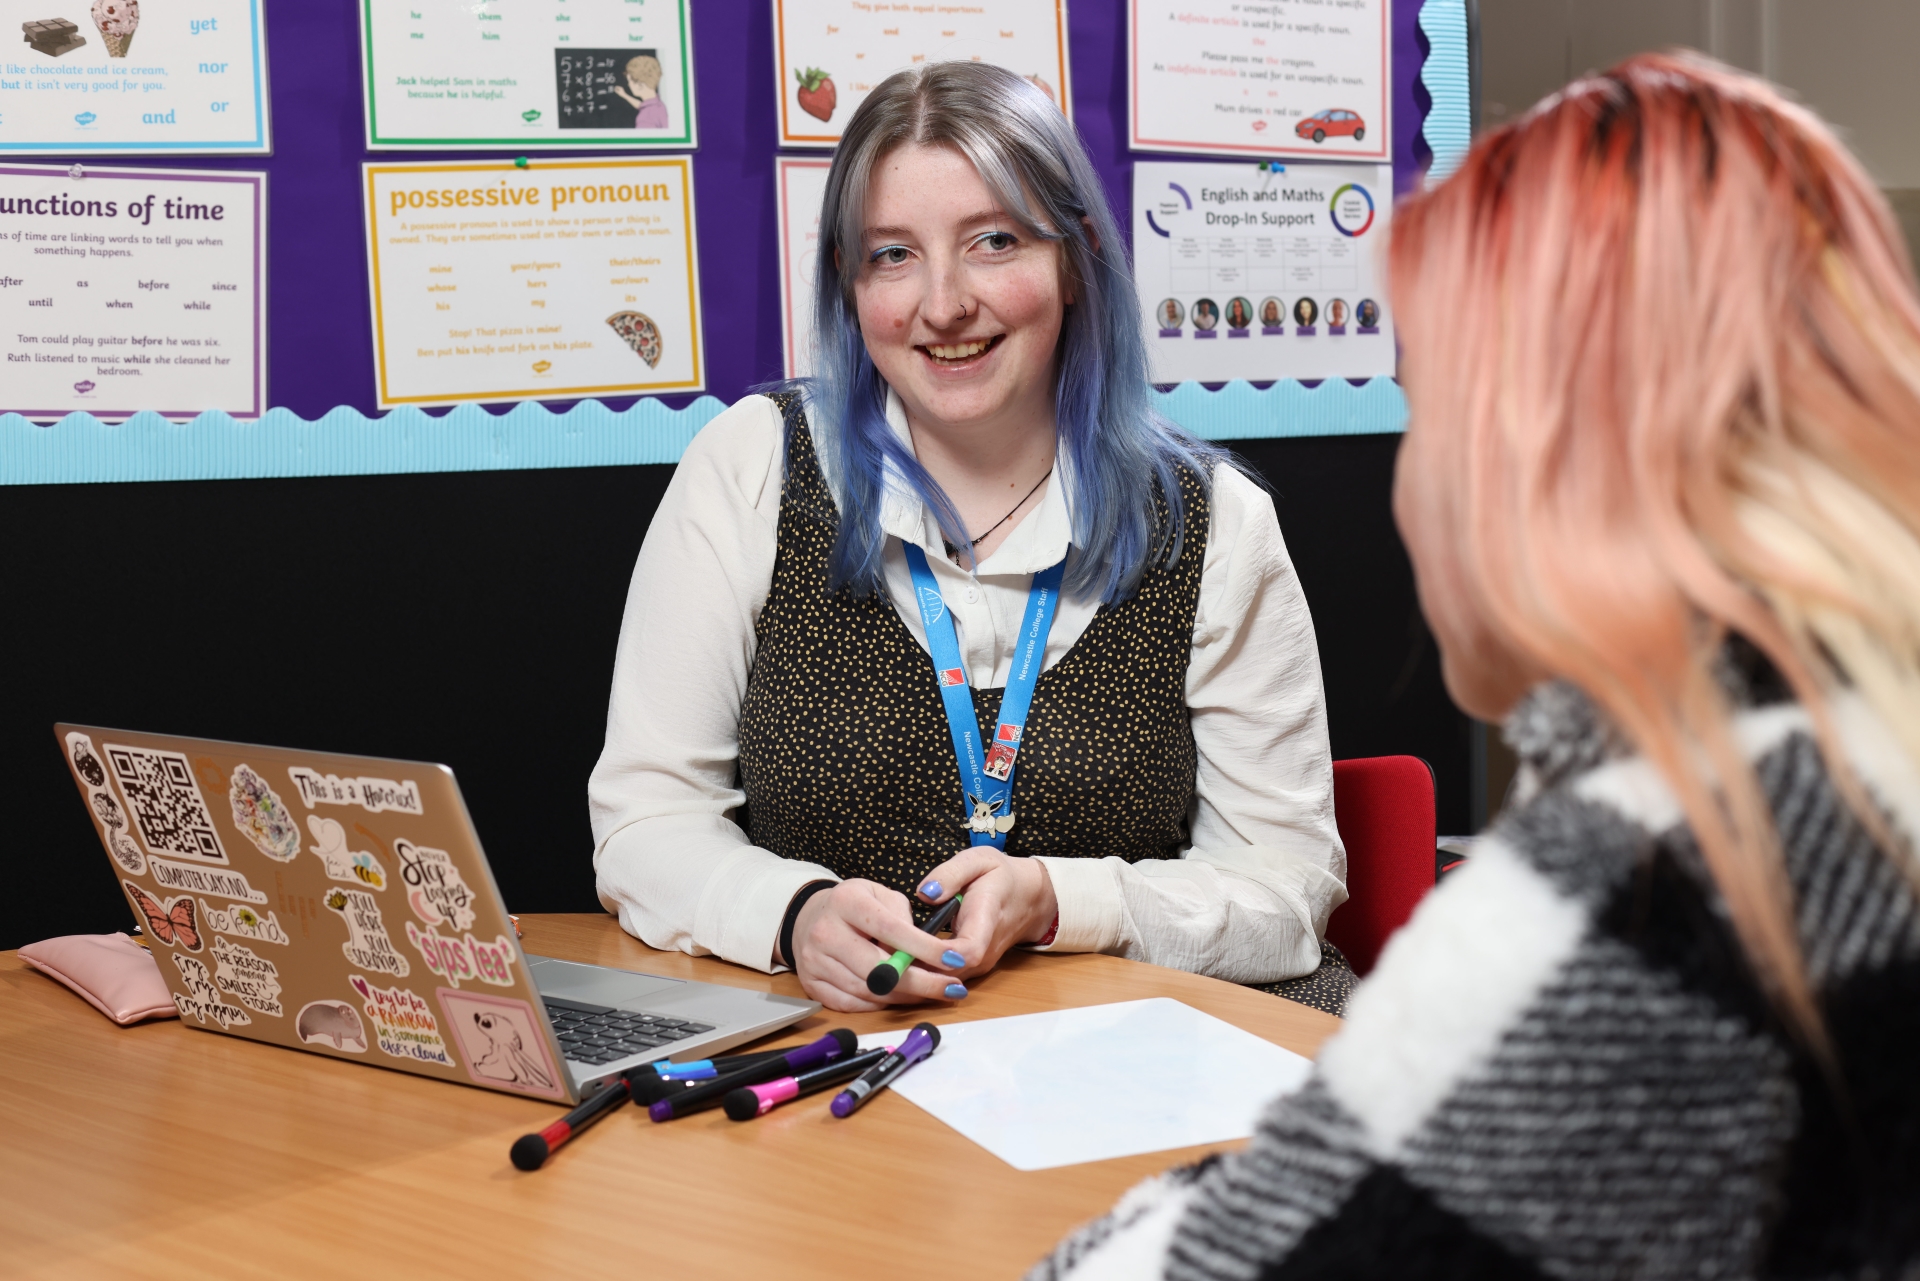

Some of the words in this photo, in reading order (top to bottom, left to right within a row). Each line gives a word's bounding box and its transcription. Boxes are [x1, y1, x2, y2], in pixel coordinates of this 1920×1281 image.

[478, 12, 502, 21] them
[556, 13, 571, 22] she
[629, 15, 642, 23] we
[190, 18, 218, 35] yet
[482, 32, 500, 41] him
[559, 34, 570, 42] us
[629, 34, 644, 43] her
[6, 64, 26, 74] like
[30, 64, 83, 74] chocolate
[87, 64, 108, 74] and
[112, 65, 128, 74] ice
[131, 66, 168, 76] cream,
[199, 62, 228, 74] nor
[1, 79, 20, 90] but
[24, 80, 32, 90] it
[37, 79, 60, 90] isn't
[64, 81, 88, 92] very
[92, 80, 119, 92] good
[122, 79, 138, 92] for
[142, 81, 166, 92] you.
[396, 76, 416, 86] Jack
[420, 77, 450, 88] helped
[453, 77, 473, 86] Sam
[476, 78, 485, 86] in
[488, 77, 517, 86] maths
[408, 90, 444, 99] because
[447, 90, 458, 99] he
[461, 90, 469, 98] is
[472, 90, 506, 102] helpful.
[210, 101, 229, 112] or
[142, 108, 176, 124] and
[390, 180, 540, 216] possessive
[550, 183, 670, 212] pronoun
[1202, 188, 1249, 204] English
[1253, 188, 1278, 202] and
[1282, 188, 1325, 202] Maths
[128, 195, 156, 226] of
[164, 197, 224, 220] time
[1206, 212, 1257, 228] Drop-In
[1262, 212, 1315, 228] Support
[12, 230, 22, 242] of
[24, 232, 47, 241] time
[51, 234, 67, 242] are
[70, 232, 105, 245] linking
[108, 234, 139, 244] words
[142, 236, 152, 244] to
[156, 234, 172, 245] tell
[175, 237, 193, 248] you
[196, 236, 223, 246] when
[34, 246, 86, 258] something
[90, 247, 134, 260] happens.
[429, 265, 452, 273] mine
[510, 261, 561, 272] your/yours
[609, 257, 661, 267] their/theirs
[0, 276, 23, 288] after
[77, 280, 89, 288] as
[138, 280, 170, 292] before
[212, 282, 237, 291] since
[427, 283, 457, 293] whose
[527, 280, 547, 289] hers
[29, 298, 53, 307] until
[106, 300, 133, 309] when
[184, 301, 211, 311] while
[436, 303, 450, 311] his
[531, 299, 545, 308] my
[476, 327, 496, 336] That
[499, 327, 523, 338] pizza
[526, 326, 534, 334] is
[17, 334, 38, 344] Tom
[42, 335, 69, 344] could
[72, 335, 94, 346] play
[97, 336, 128, 346] guitar
[131, 336, 163, 347] before
[166, 337, 178, 345] he
[204, 338, 221, 346] six.
[438, 348, 453, 359] put
[456, 346, 470, 356] his
[473, 345, 495, 357] knife
[498, 344, 515, 354] and
[518, 344, 536, 355] fork
[554, 342, 567, 351] his
[8, 353, 31, 362] Ruth
[35, 354, 74, 363] listened
[78, 355, 87, 363] to
[91, 355, 120, 364] music
[123, 355, 151, 364] while
[154, 355, 171, 364] she
[174, 356, 211, 365] cleaned
[214, 356, 231, 365] her
[97, 366, 142, 376] bedroom.
[918, 586, 926, 608] Newcastle
[1018, 640, 1036, 681] Newcastle
[1030, 608, 1044, 638] College
[1037, 587, 1049, 606] Staff
[938, 670, 948, 687] NCG
[1013, 726, 1022, 742] NCG
[964, 731, 978, 775] Newcastle
[294, 774, 328, 802] This
[331, 782, 344, 800] is
[348, 785, 356, 799] a
[152, 862, 208, 890] COMPUTER
[204, 872, 230, 894] SAYS
[203, 900, 229, 931] be
[212, 950, 232, 965] THE
[233, 955, 275, 974] REASON
[250, 998, 280, 1014] TODAY
[373, 989, 398, 1014] try
[394, 988, 408, 1007] to
[411, 994, 426, 1011] be
[367, 1004, 380, 1016] a
[381, 1010, 436, 1031] RAINBOW
[378, 1025, 391, 1037] in
[392, 1029, 443, 1046] someone
[411, 1045, 448, 1063] cloud
